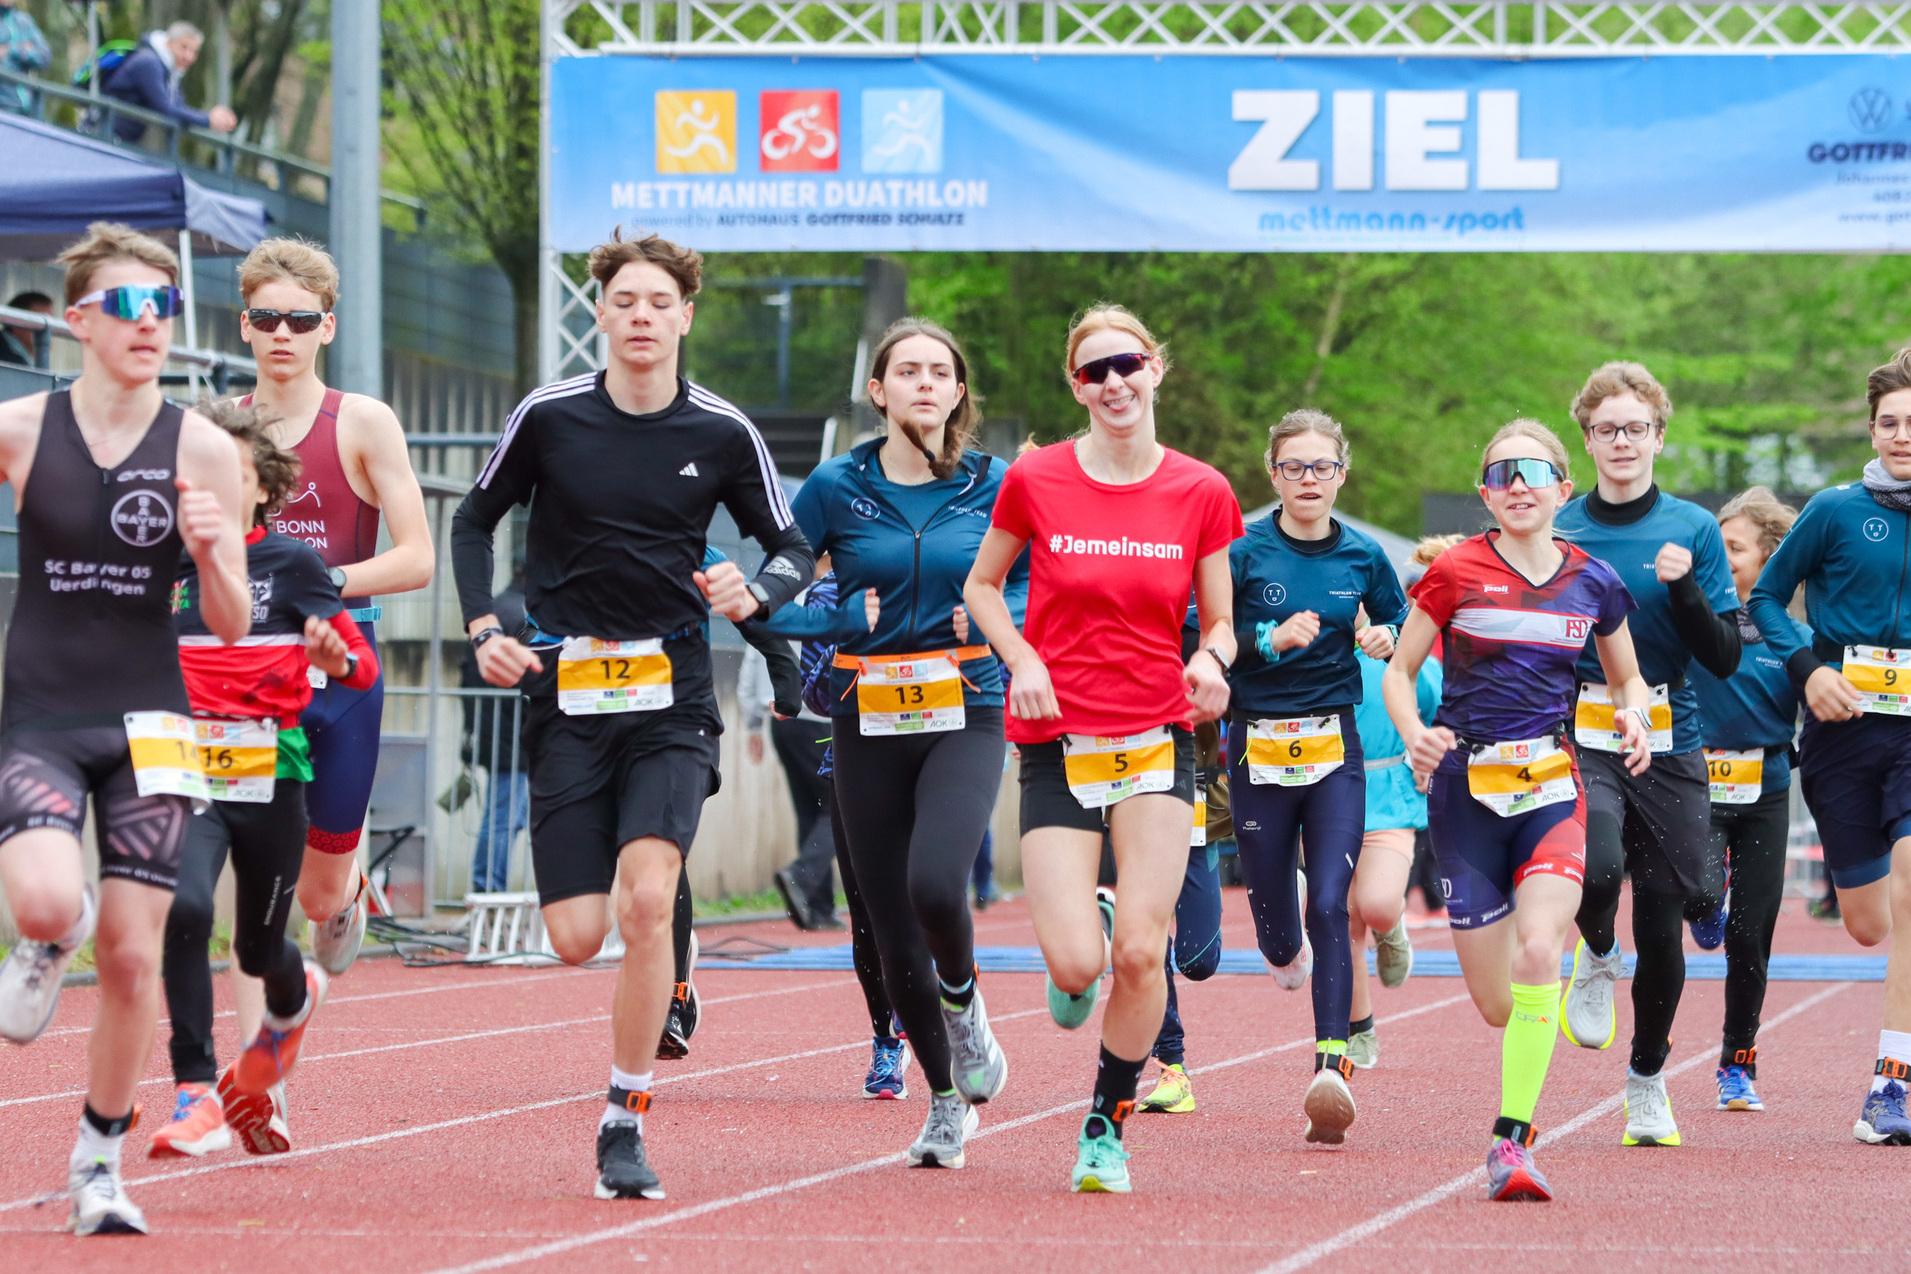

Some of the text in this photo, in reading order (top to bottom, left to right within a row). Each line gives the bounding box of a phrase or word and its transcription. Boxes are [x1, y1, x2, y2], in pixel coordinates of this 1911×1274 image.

[1228, 90, 1559, 191] ZIEL
[1809, 141, 1911, 164] GOTTFR
[610, 180, 988, 208] METTMANNER DUATHLON
[717, 214, 799, 227] AUTOHAUS
[806, 213, 892, 227] GOTTFRIED
[116, 513, 168, 528] BAYER
[277, 520, 326, 534] BONN
[1049, 534, 1184, 560] #Jemeinsam
[44, 560, 65, 575] SC
[131, 566, 152, 579] 05
[50, 578, 146, 596] Uerdingen
[600, 660, 630, 679] 12
[1884, 669, 1897, 686] 9
[895, 686, 924, 705] 13
[930, 719, 948, 728] AOK
[203, 747, 233, 769] 16
[1288, 740, 1302, 758] 6
[1114, 753, 1128, 773] 5
[1708, 761, 1732, 777] 10
[1516, 767, 1533, 782] 4
